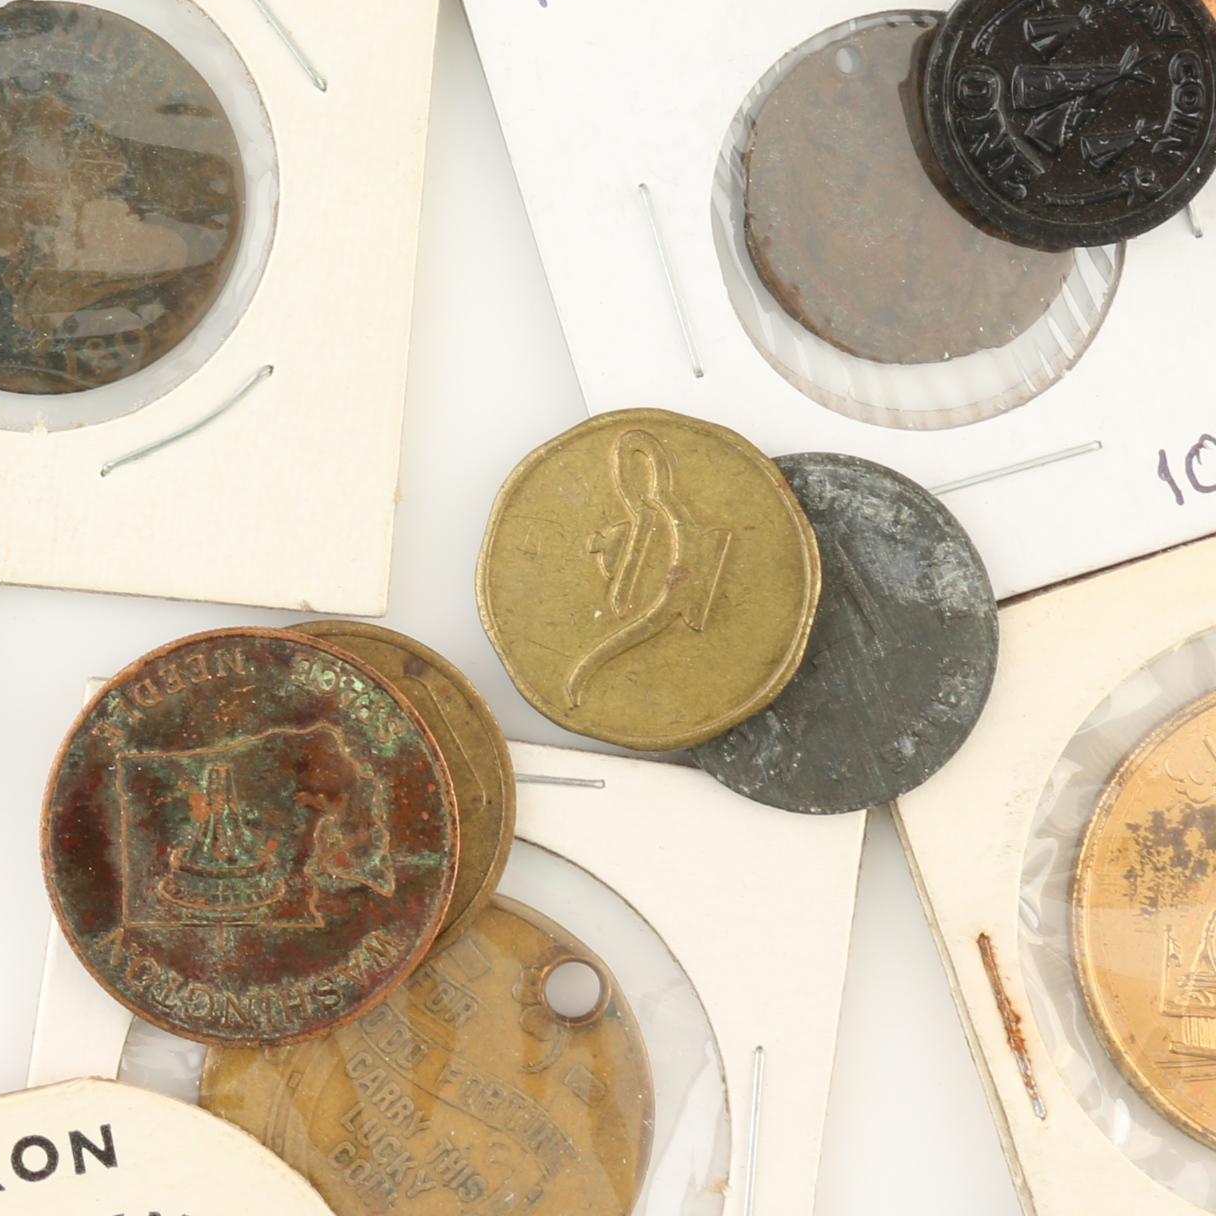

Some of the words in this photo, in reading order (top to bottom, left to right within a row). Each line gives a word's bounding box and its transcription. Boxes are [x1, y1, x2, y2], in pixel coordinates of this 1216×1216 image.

[98, 928, 409, 1029] WASHINGTON
[339, 1101, 437, 1201] LUCKY
[343, 1050, 434, 1141] CARRY
[426, 1134, 490, 1204] THIS
